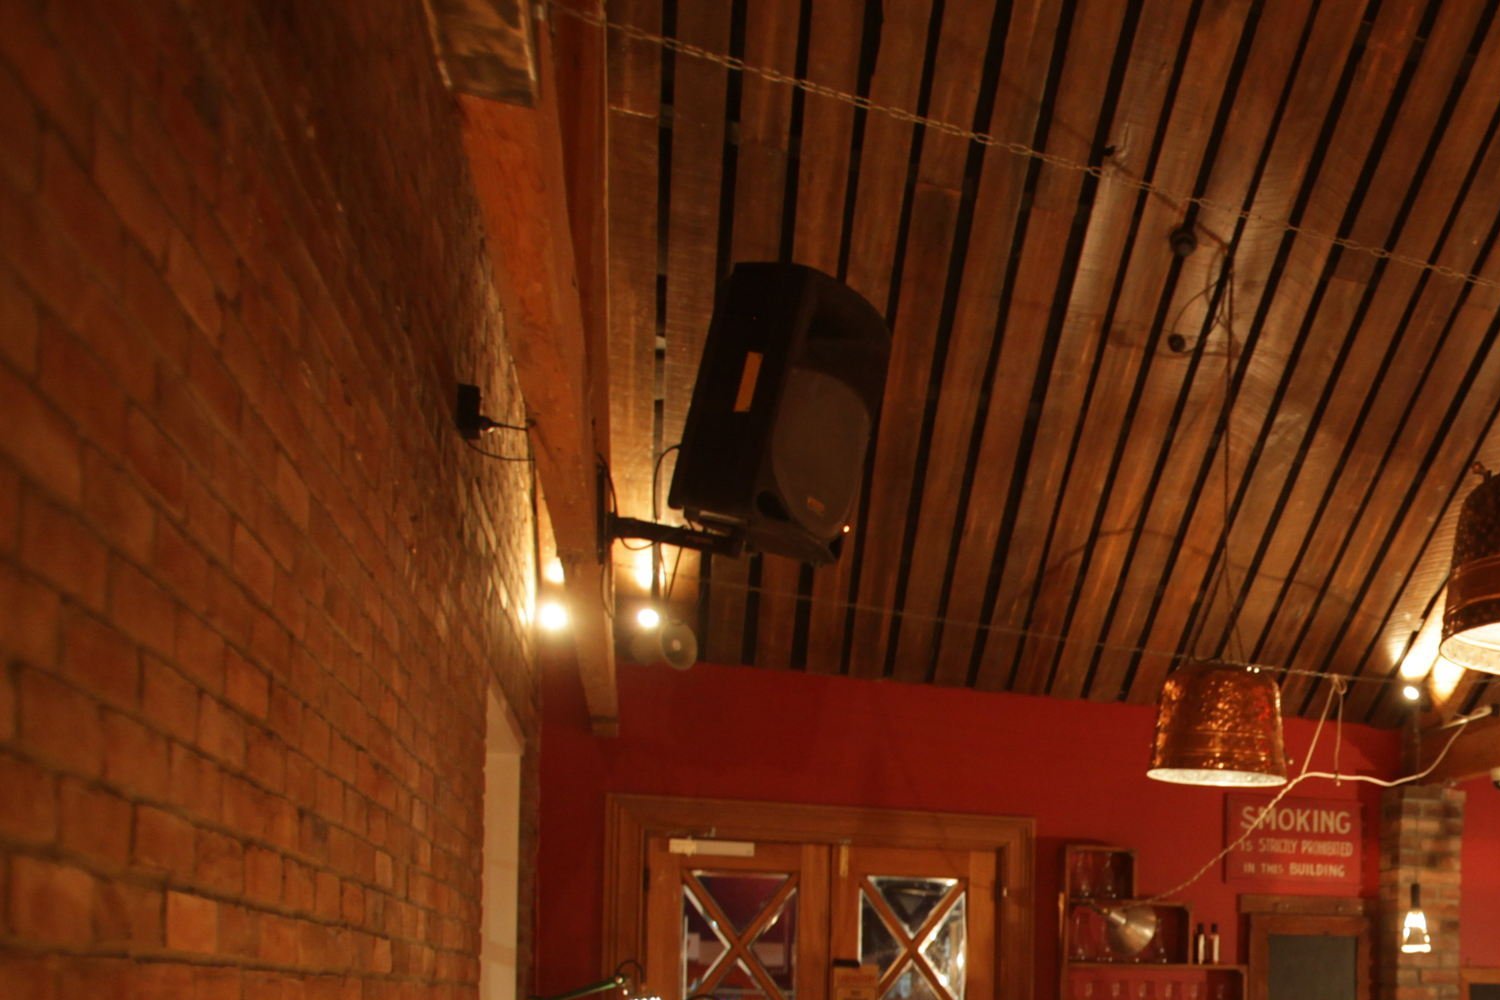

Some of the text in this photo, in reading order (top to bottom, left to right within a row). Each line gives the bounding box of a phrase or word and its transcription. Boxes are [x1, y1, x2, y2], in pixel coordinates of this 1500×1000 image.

[1240, 806, 1351, 834] SMOKING
[1301, 840, 1353, 857] PROHIBITED
[1244, 862, 1345, 878] IN THIS BUILDING
